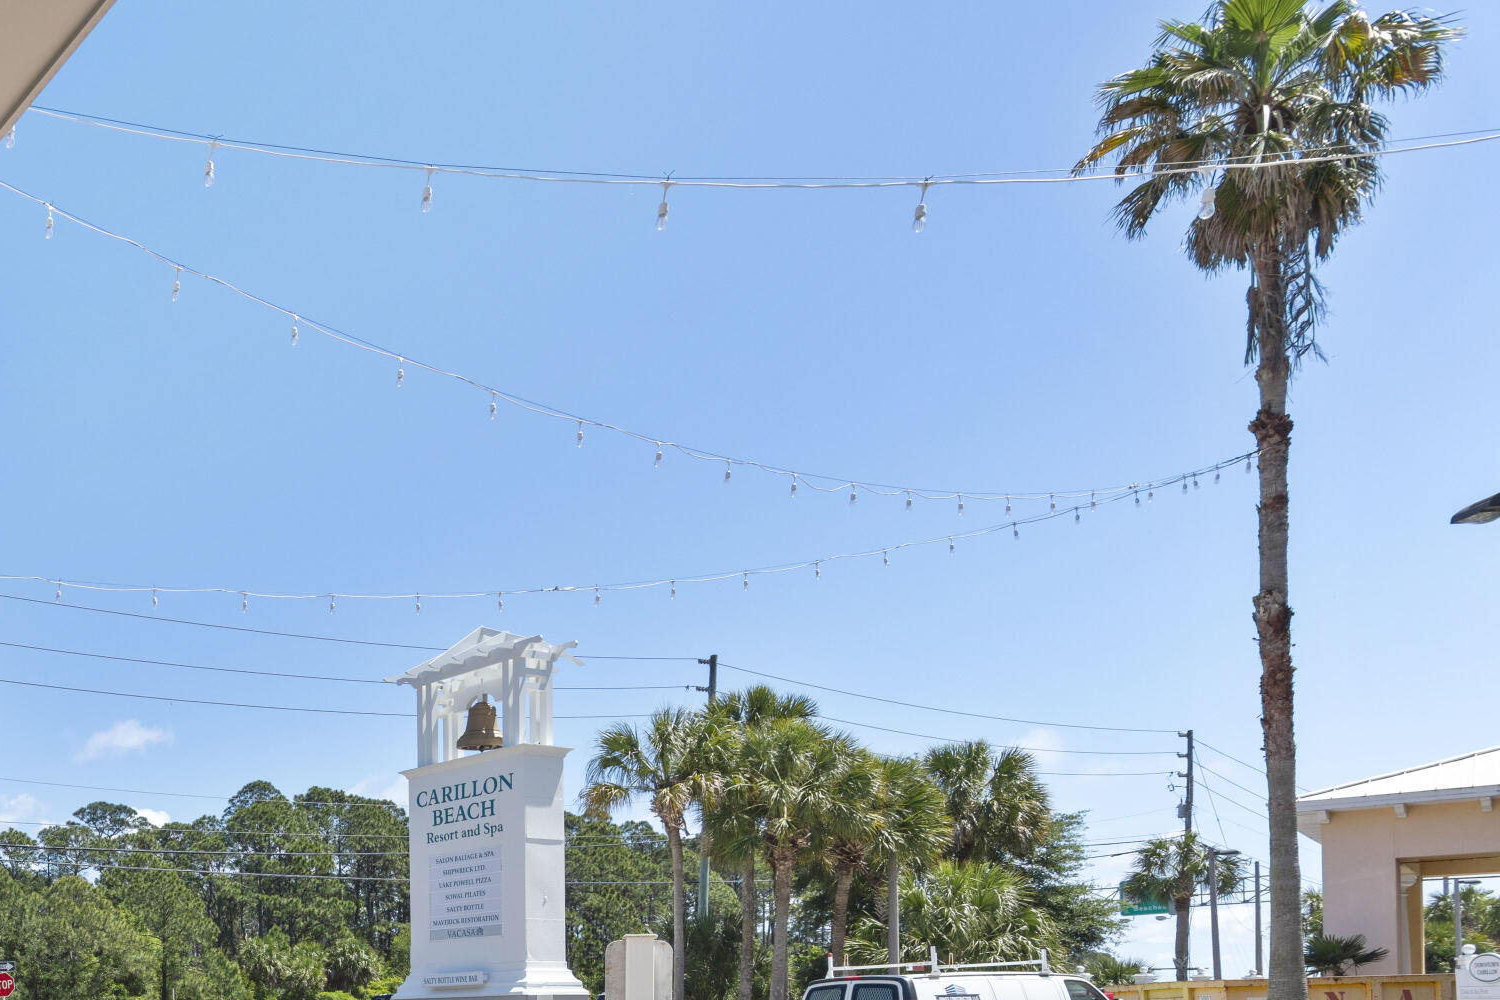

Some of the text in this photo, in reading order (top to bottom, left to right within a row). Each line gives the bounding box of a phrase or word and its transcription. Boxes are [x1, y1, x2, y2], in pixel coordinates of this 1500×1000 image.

[416, 772, 514, 808] CARILLON
[432, 799, 496, 826] BEACH
[426, 822, 504, 844] Resort and Spa
[435, 856, 454, 865] SALON
[483, 850, 495, 858] SPA
[475, 876, 492, 884] PIZZA
[463, 903, 484, 911] BOTTLE
